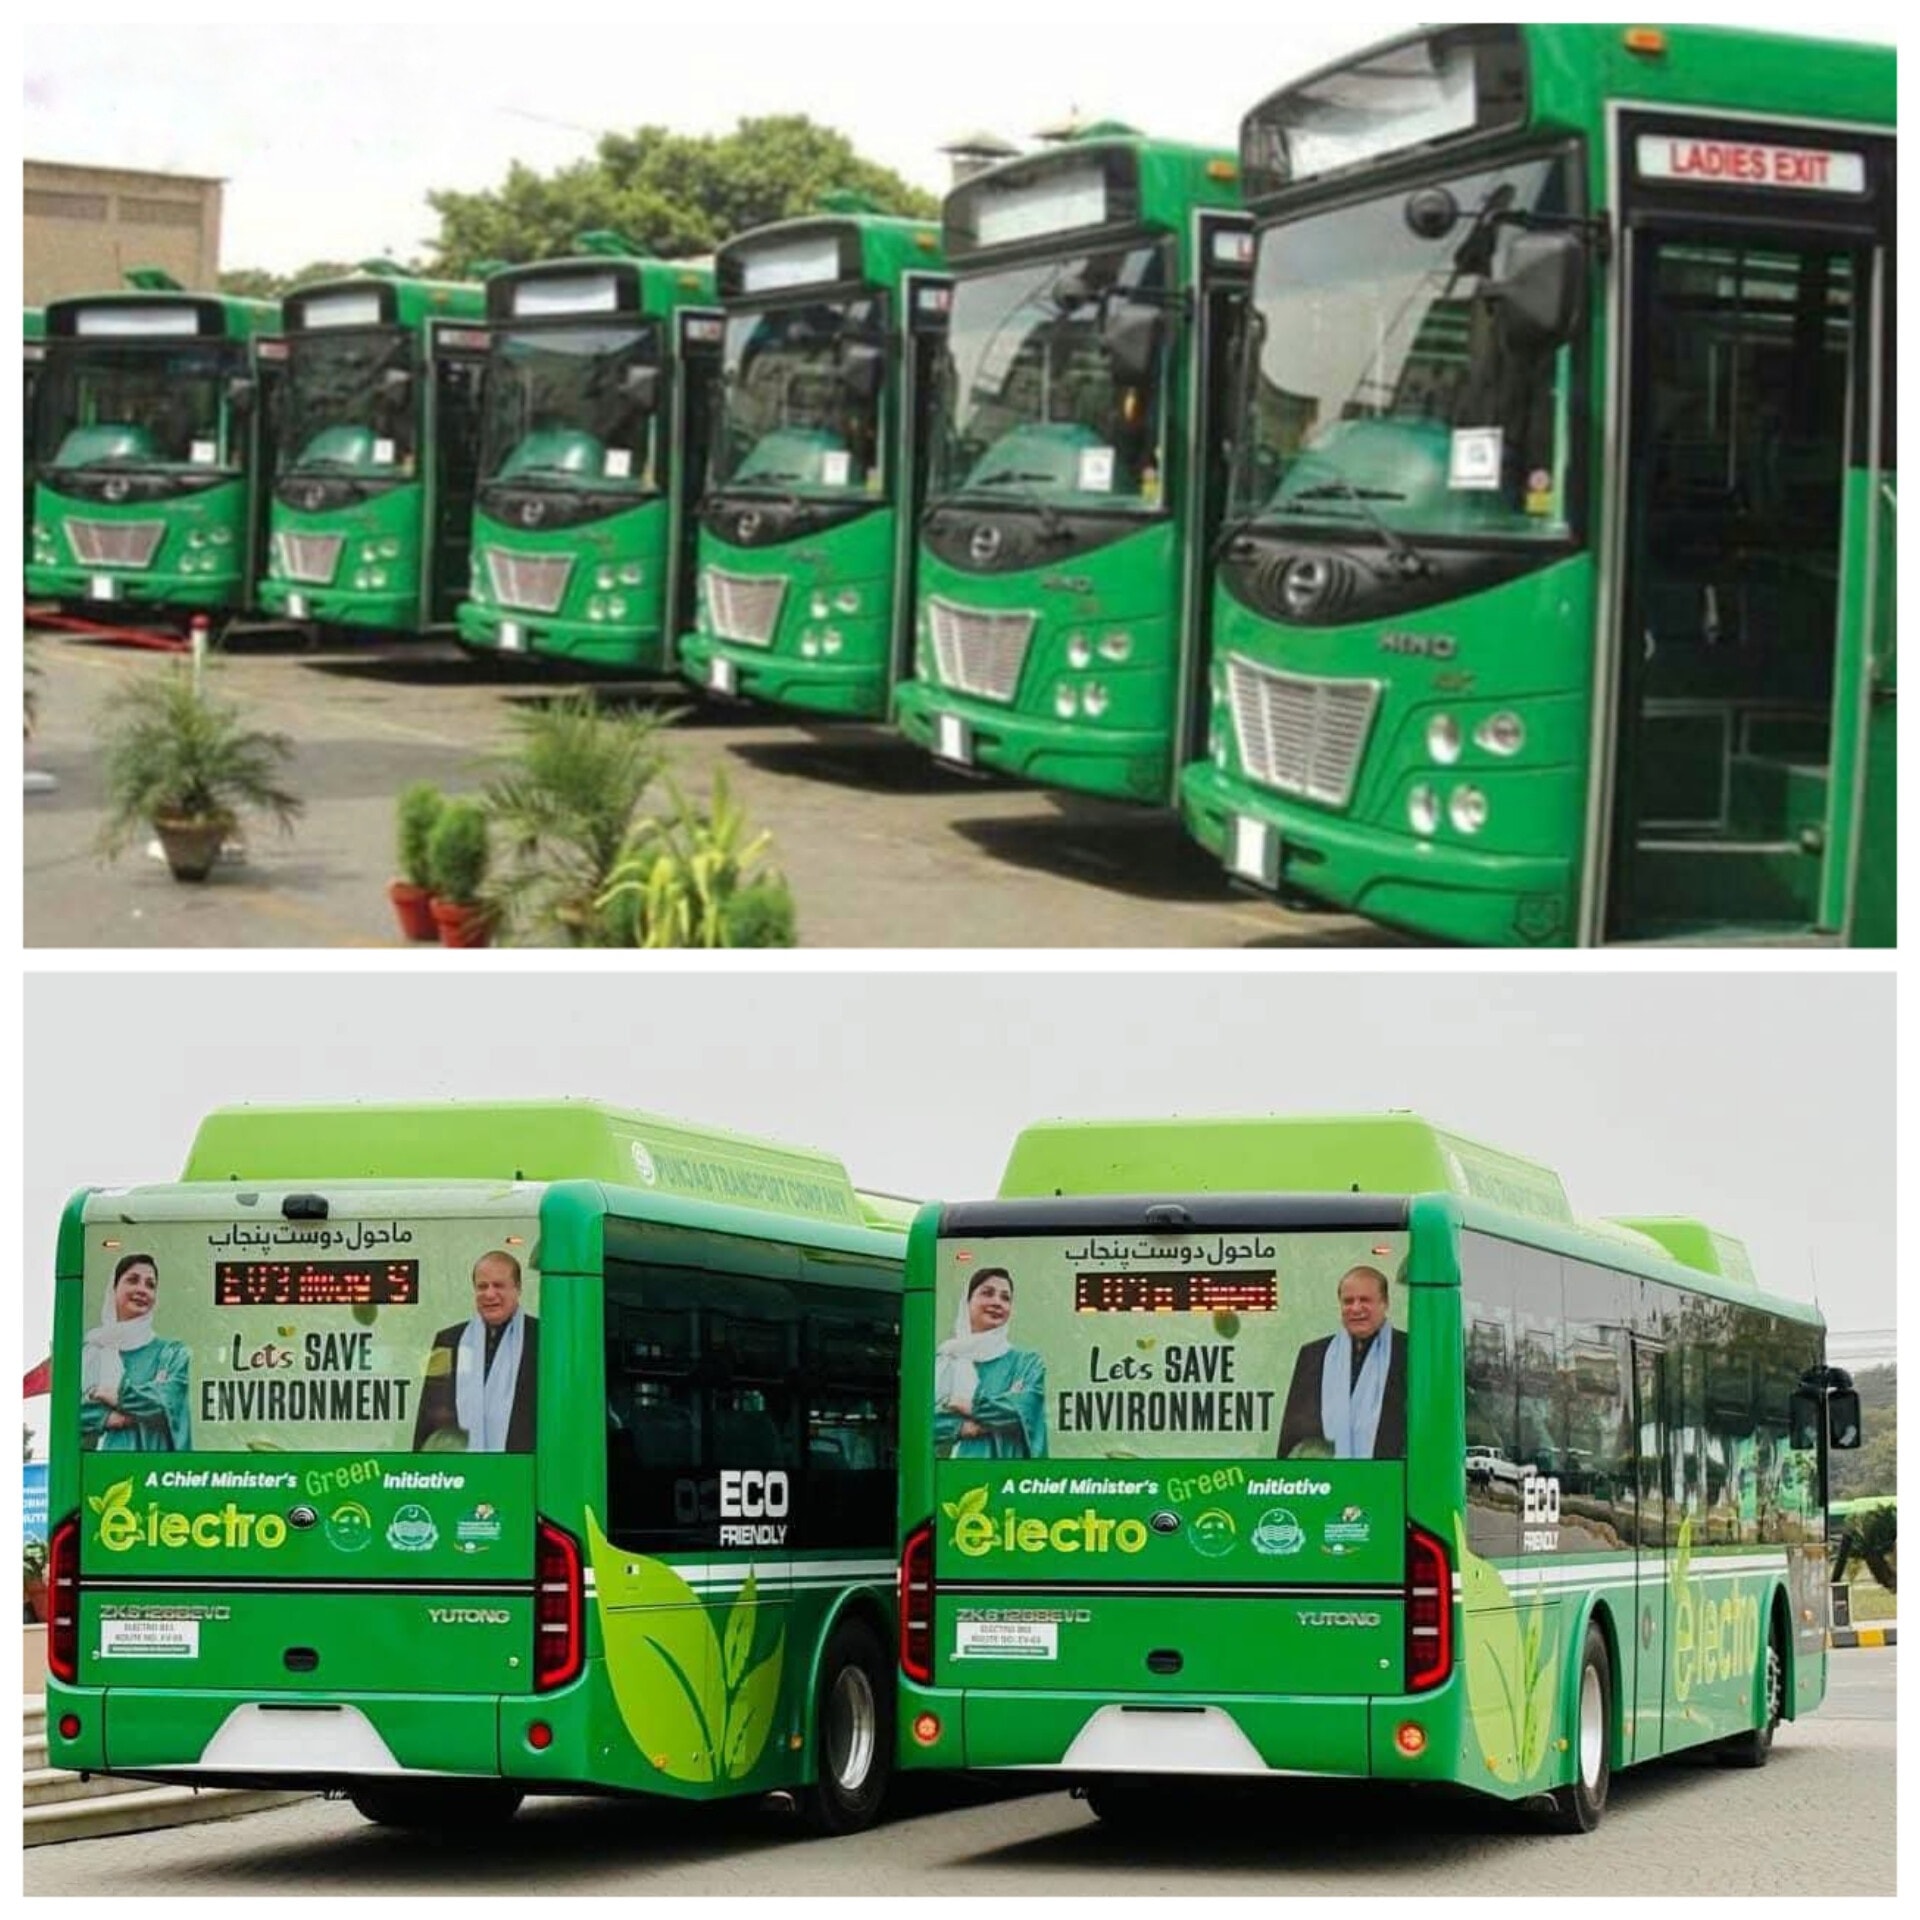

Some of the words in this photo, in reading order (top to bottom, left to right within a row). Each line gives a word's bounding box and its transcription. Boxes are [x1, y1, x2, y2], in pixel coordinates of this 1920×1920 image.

[1670, 141, 1767, 180] LADIES
[1775, 152, 1830, 184] EXIT
[208, 1223, 272, 1256] پنجاب
[273, 1226, 344, 1249] دوست
[346, 1222, 412, 1250] ماحول
[1131, 1241, 1205, 1265] دوست
[1206, 1237, 1275, 1265] ماحول
[1065, 1238, 1130, 1270] پنجاب
[305, 1332, 373, 1371] SAVE
[1164, 1345, 1235, 1383] SAVE
[202, 1379, 411, 1421] ENVIRONMENT
[1058, 1391, 1275, 1432] ENVIRONMENT
[145, 1472, 158, 1487] A
[161, 1471, 212, 1488] Chief
[211, 1471, 297, 1488] Minister's
[305, 1458, 380, 1497] Green
[383, 1472, 465, 1489] Initiative
[719, 1469, 789, 1518] ECO
[1002, 1479, 1015, 1494] A
[1018, 1478, 1068, 1495] Chief
[1069, 1478, 1158, 1495] Minister's
[1166, 1466, 1244, 1503] Green
[1247, 1479, 1331, 1496] Initiative
[1524, 1477, 1560, 1523] ECO
[719, 1524, 788, 1546] FRIENDLY
[427, 1608, 510, 1623] YUTONG
[1297, 1611, 1381, 1626] YUTONG
